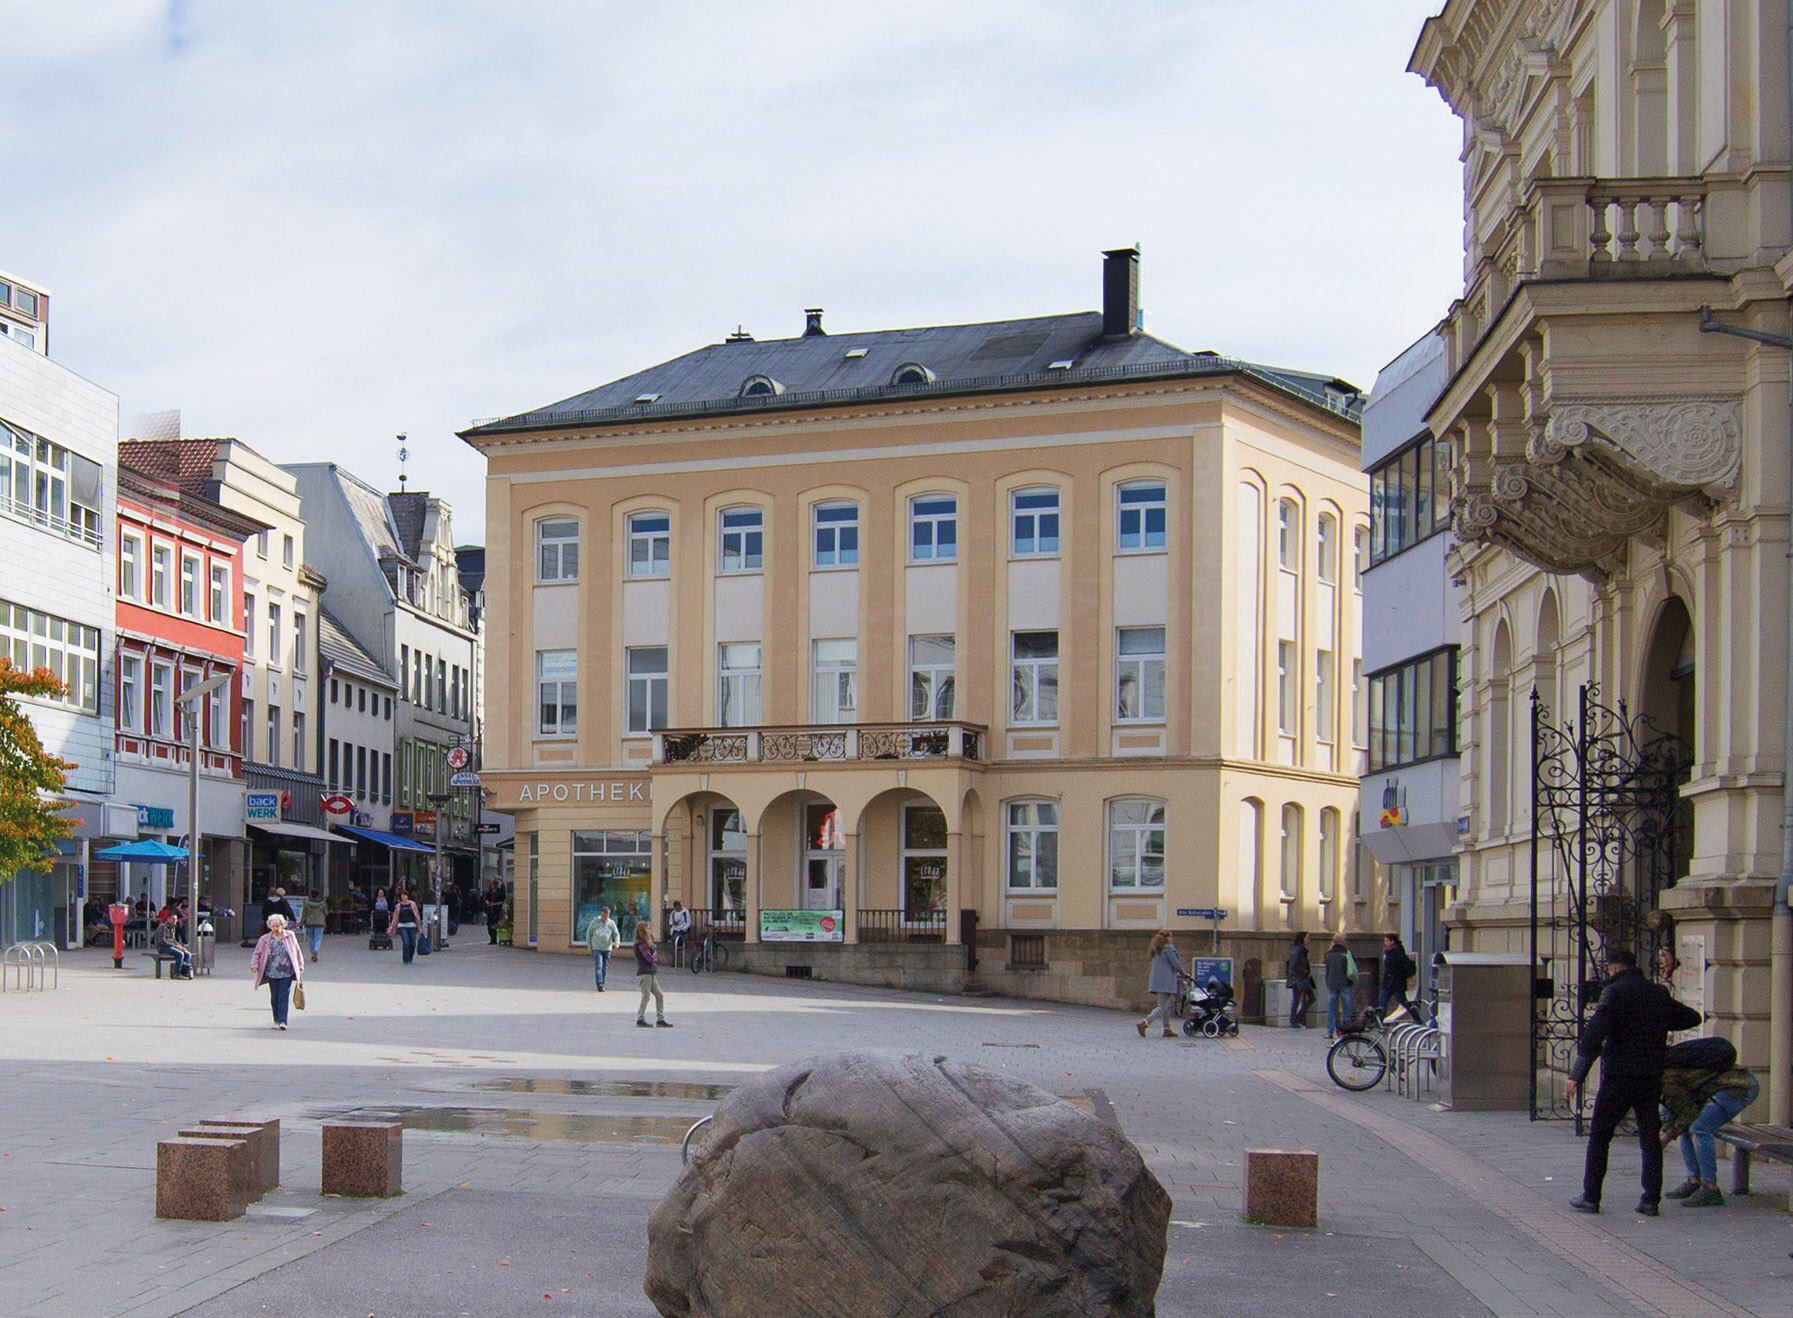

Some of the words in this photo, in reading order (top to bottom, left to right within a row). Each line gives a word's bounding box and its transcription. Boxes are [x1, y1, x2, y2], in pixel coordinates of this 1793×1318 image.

[519, 783, 653, 801] APOTHEK
[249, 794, 276, 806] back
[247, 808, 277, 819] WERK
